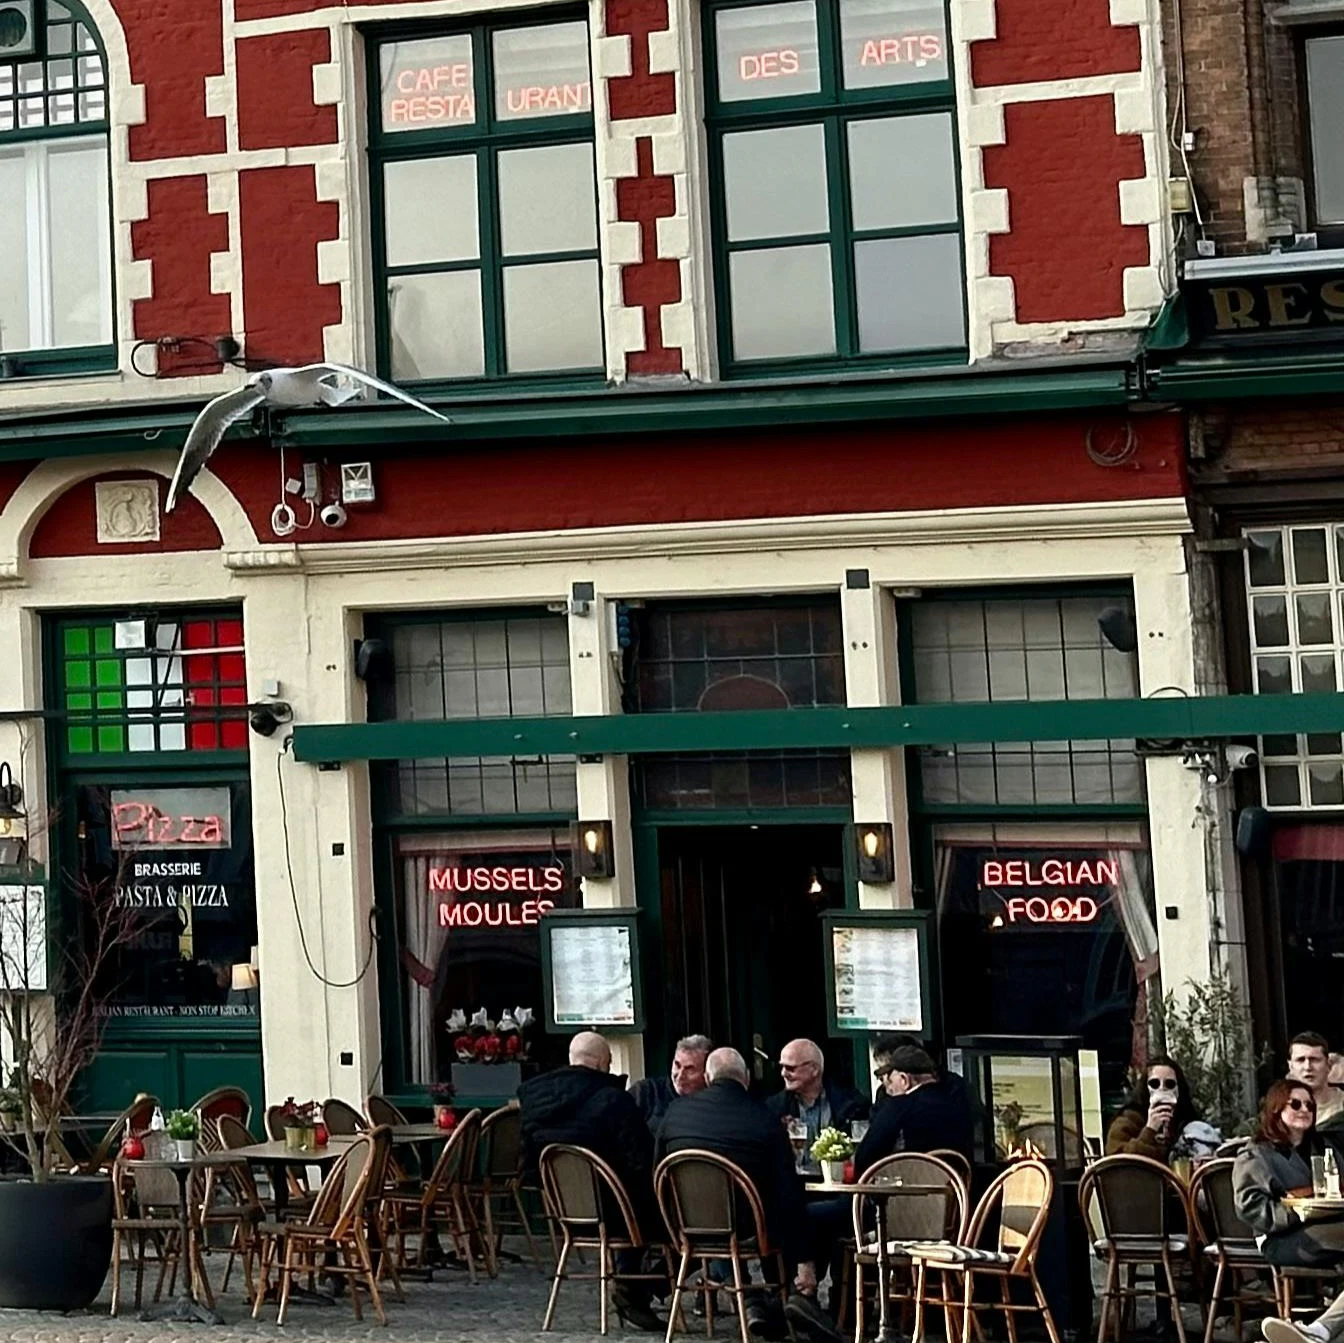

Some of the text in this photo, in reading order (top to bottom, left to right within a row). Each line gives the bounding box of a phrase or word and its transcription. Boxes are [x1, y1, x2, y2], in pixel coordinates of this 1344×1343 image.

[739, 34, 942, 81] DES ARTS
[397, 63, 469, 94] CAFE
[113, 802, 223, 844] Pizza
[134, 862, 202, 877] BRASSERIE
[428, 866, 563, 892] MUSSELS
[983, 859, 1119, 887] BELGIAN
[166, 885, 178, 907] &
[182, 884, 230, 907] PIZZA
[1008, 896, 1098, 922] FOOD
